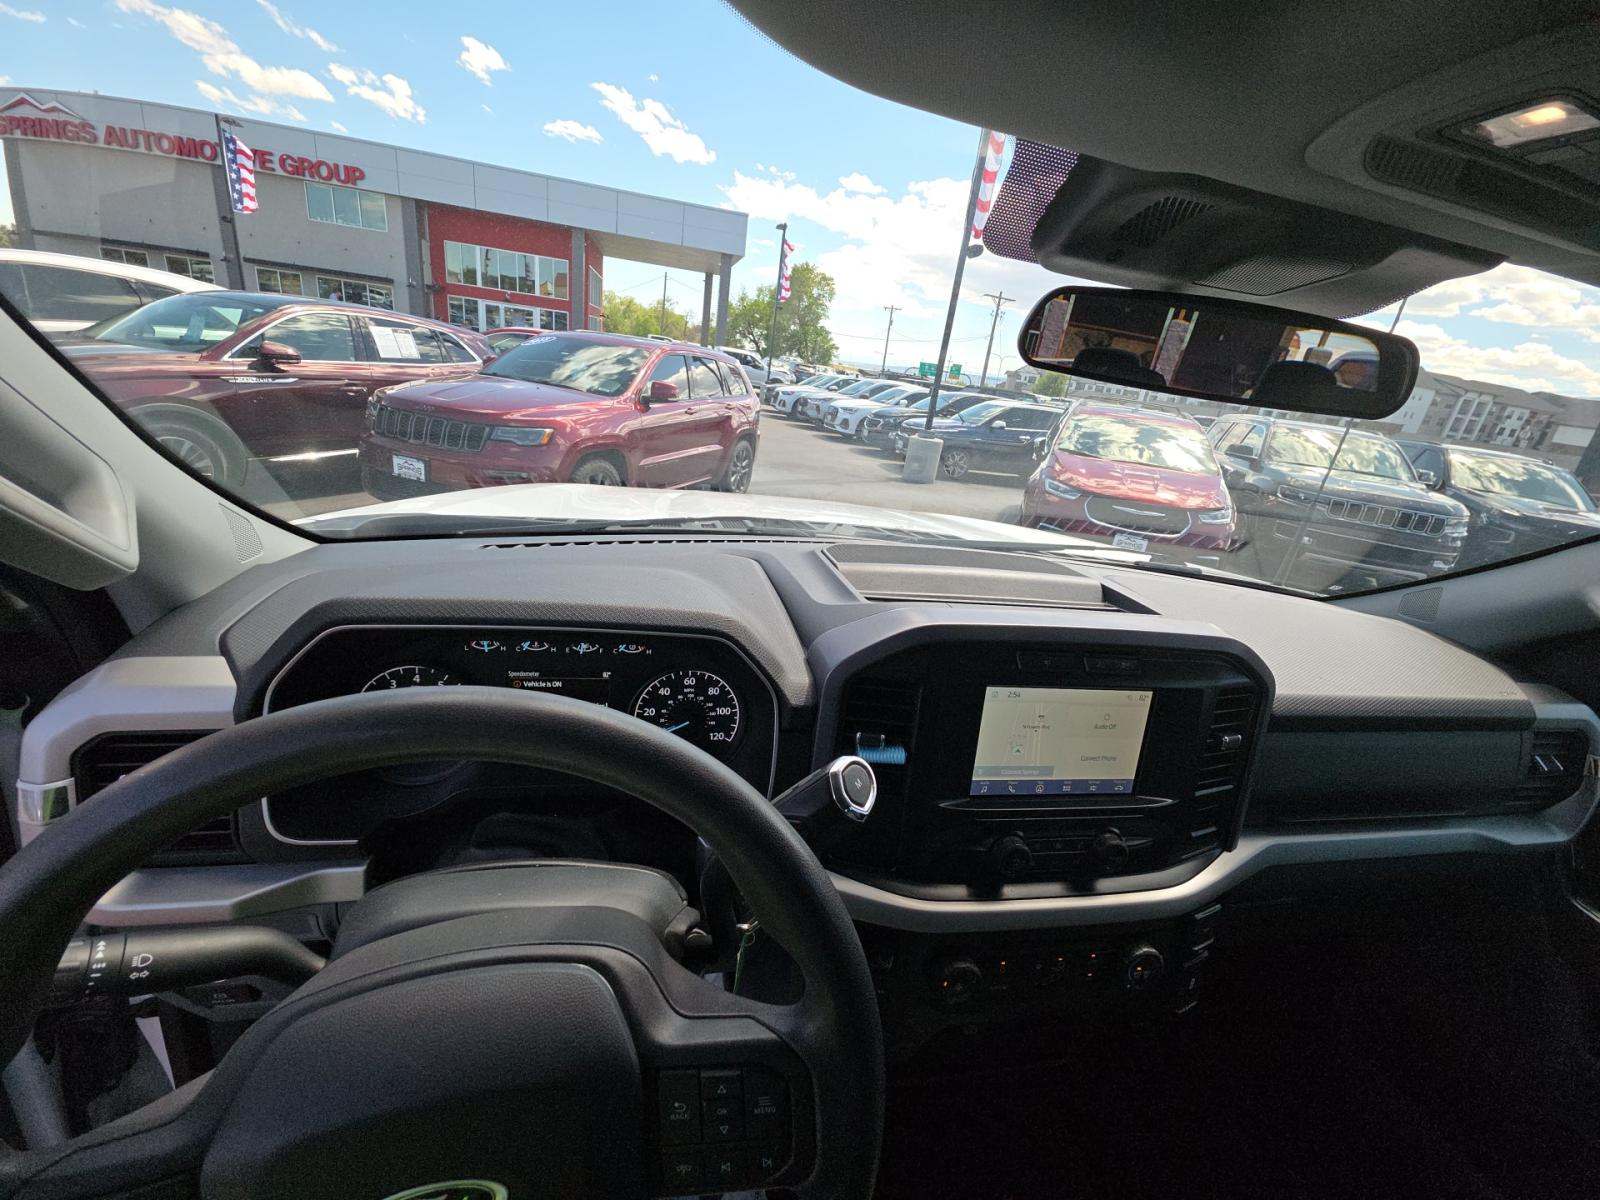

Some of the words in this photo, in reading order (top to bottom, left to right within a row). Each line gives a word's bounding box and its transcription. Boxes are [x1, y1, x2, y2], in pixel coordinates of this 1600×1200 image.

[279, 153, 365, 186] GROUP
[389, 679, 397, 688] 3
[412, 674, 420, 684] 4
[683, 677, 696, 686] 60
[523, 680, 546, 688] Vehicle
[658, 687, 671, 696] 40
[708, 687, 720, 696] 80
[643, 708, 656, 717] 20
[716, 707, 731, 716] 100
[709, 732, 725, 741] 120
